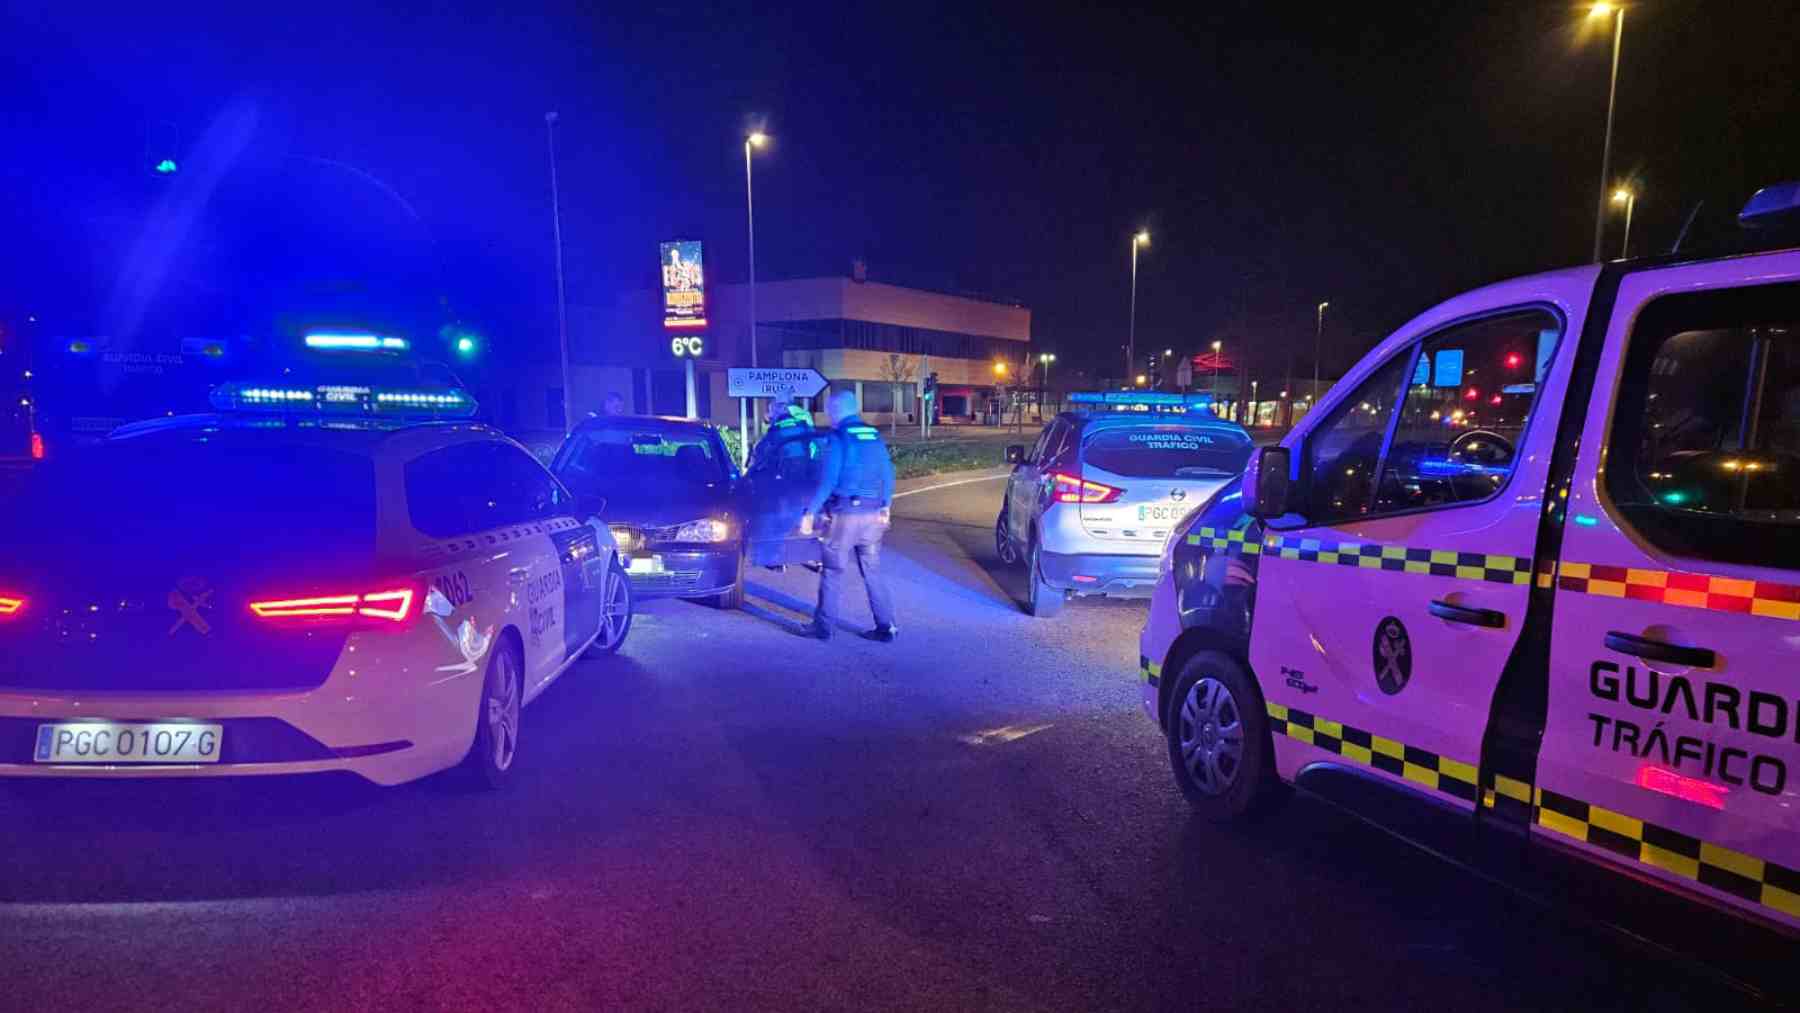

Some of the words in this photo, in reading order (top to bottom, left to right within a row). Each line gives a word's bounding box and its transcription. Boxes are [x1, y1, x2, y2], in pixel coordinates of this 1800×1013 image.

[748, 371, 809, 381] PAMPLONA
[317, 385, 370, 394] GUARDIA
[325, 391, 358, 401] CIVIL
[1129, 433, 1182, 443] GUARDIA
[1184, 434, 1214, 445] CIVIL
[528, 569, 561, 605] GUARDIA
[1587, 712, 1786, 796] TRÁFICO
